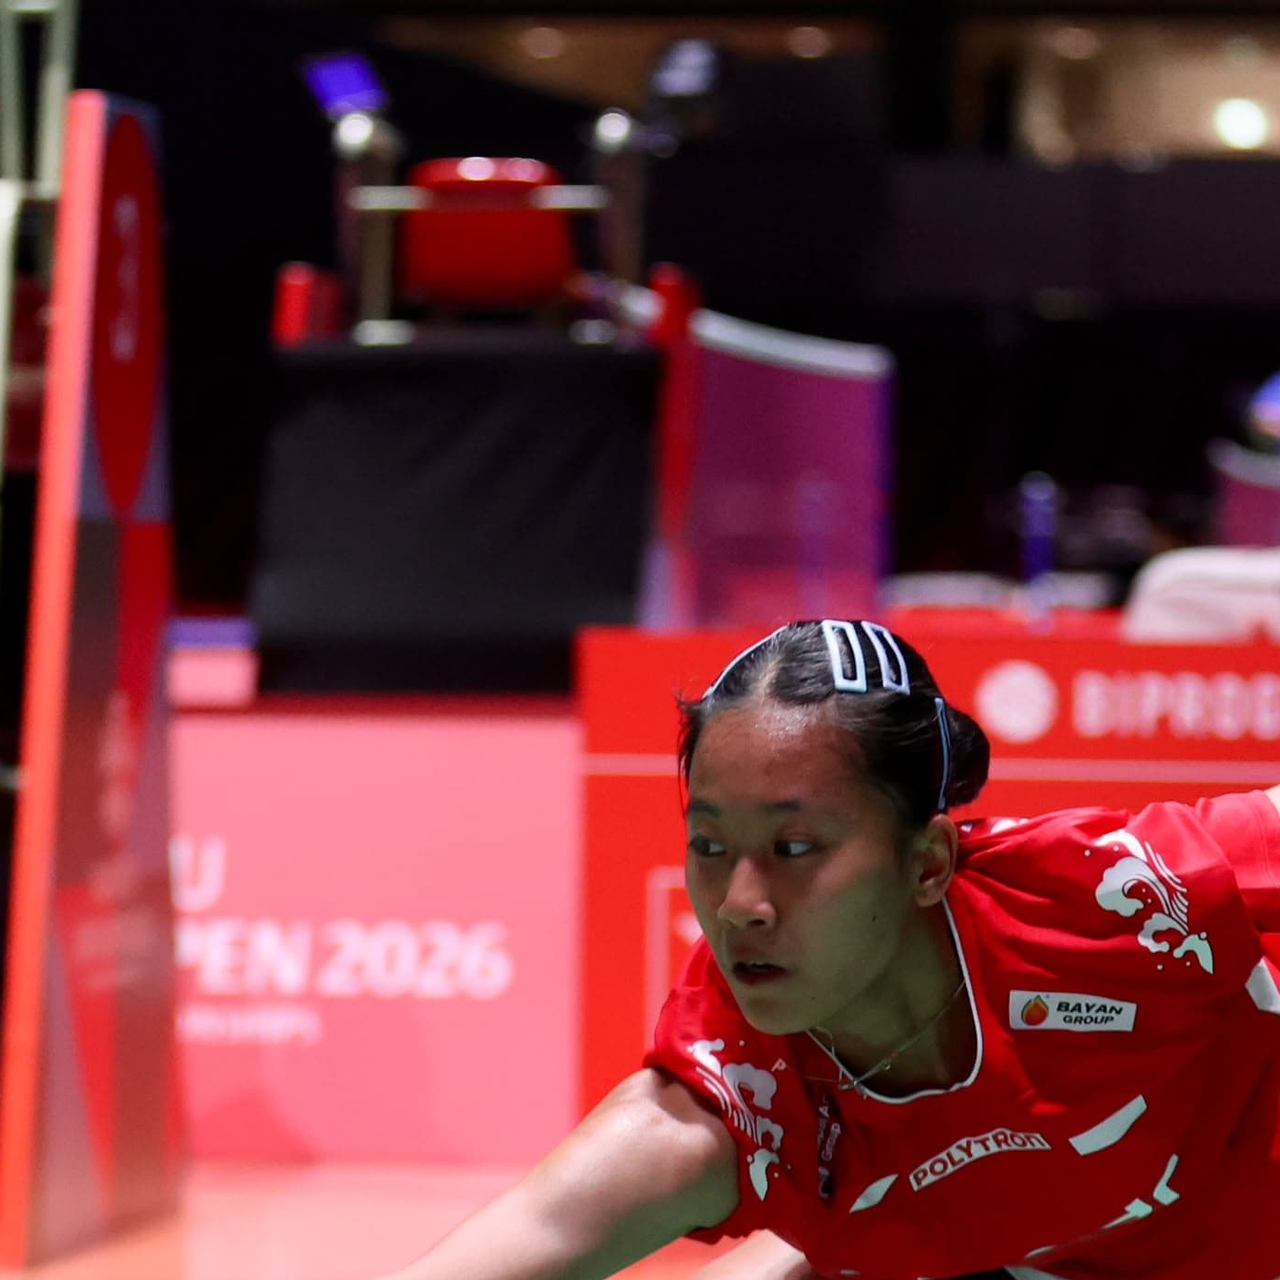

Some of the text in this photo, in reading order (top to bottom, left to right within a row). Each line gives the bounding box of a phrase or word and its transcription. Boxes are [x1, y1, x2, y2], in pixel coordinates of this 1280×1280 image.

[316, 919, 515, 999] 2026
[1056, 1001, 1123, 1016] BAYAN
[1063, 1014, 1115, 1025] GROUP
